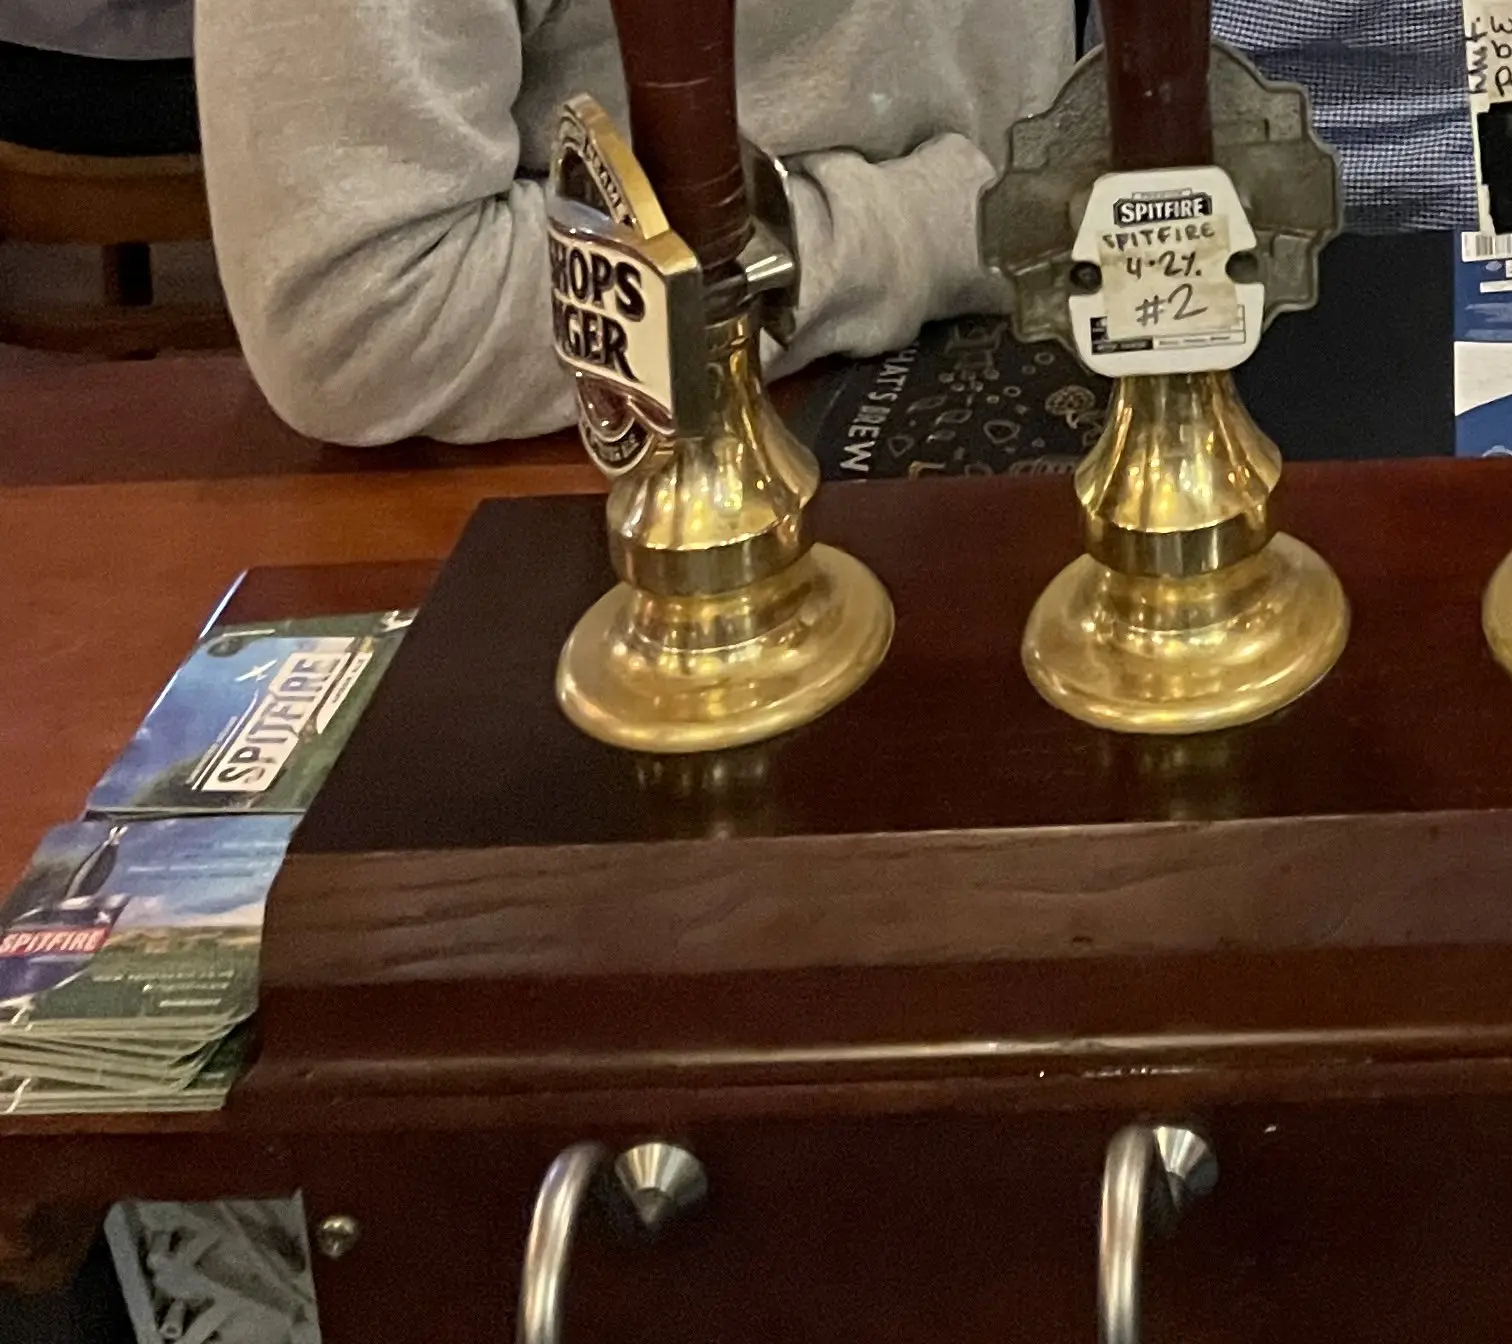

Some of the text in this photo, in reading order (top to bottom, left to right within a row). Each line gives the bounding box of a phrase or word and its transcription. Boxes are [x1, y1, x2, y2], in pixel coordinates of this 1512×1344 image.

[1120, 197, 1205, 224] SPITFIRE
[1102, 222, 1216, 252] SPITFIRE
[1135, 283, 1208, 326] #2
[216, 657, 343, 785] SPITFIRE
[0, 929, 98, 953] SPITFIRE
